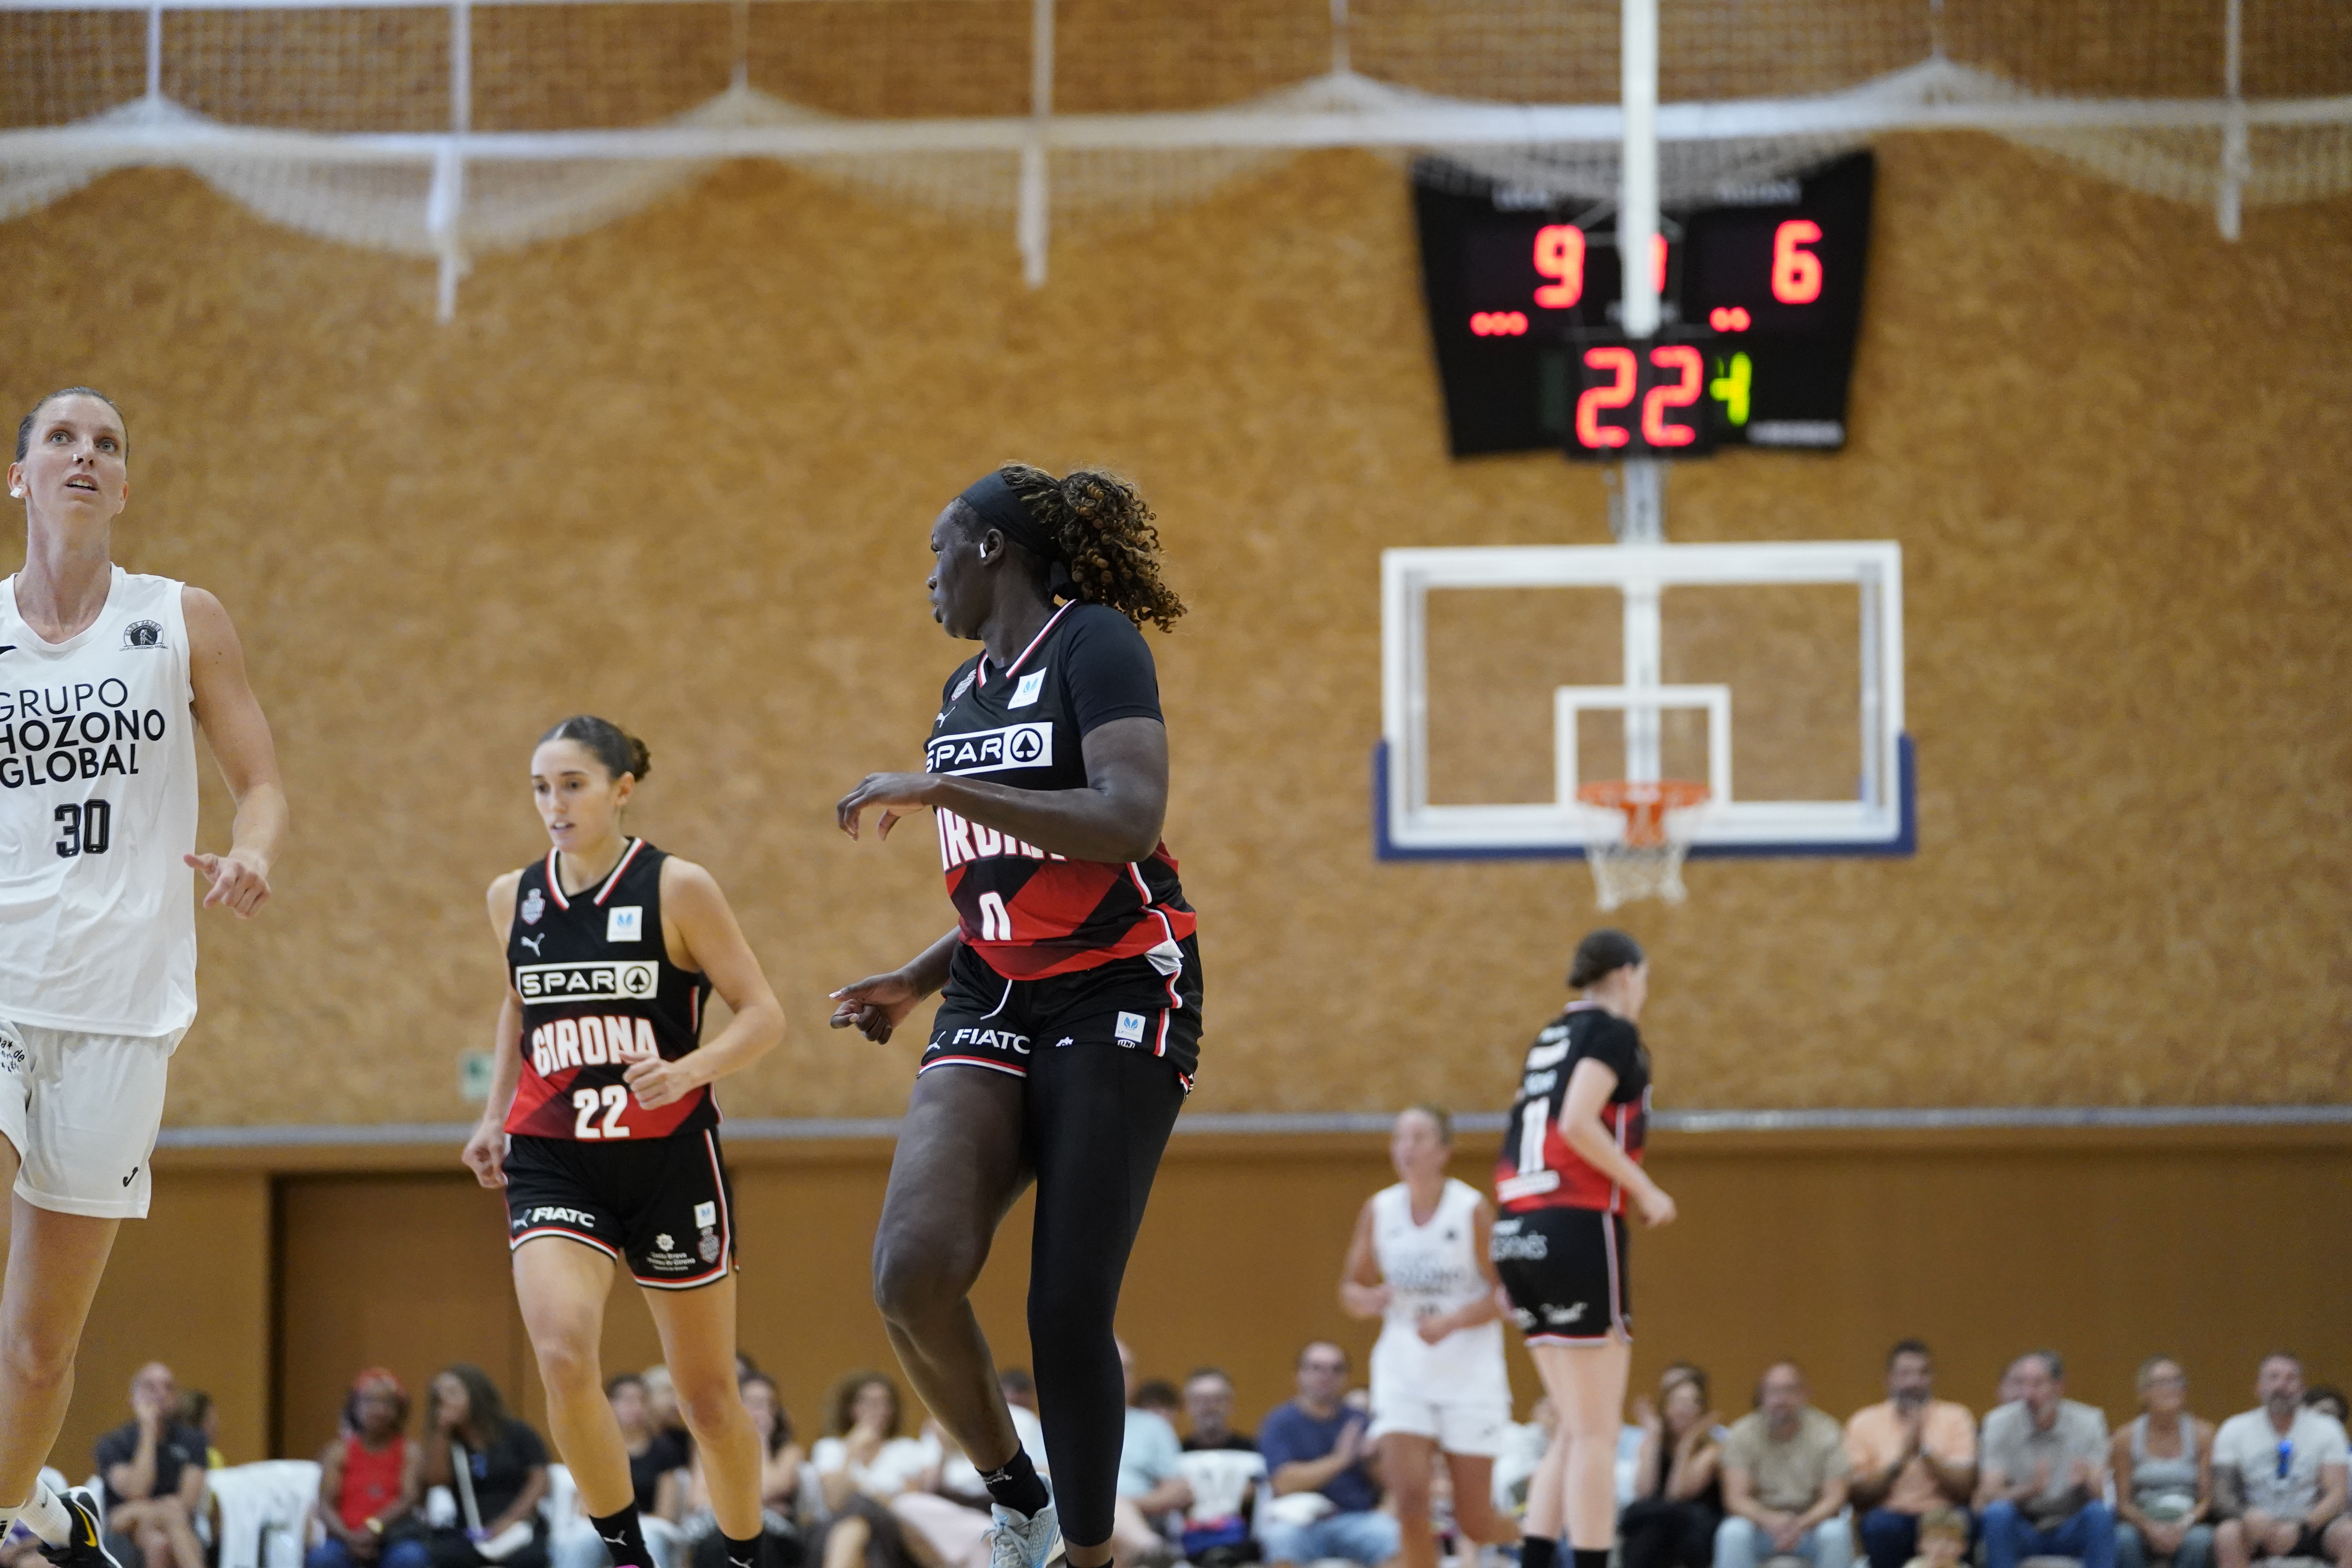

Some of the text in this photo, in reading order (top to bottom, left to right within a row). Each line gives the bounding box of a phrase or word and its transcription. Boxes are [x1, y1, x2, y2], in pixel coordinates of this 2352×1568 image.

[1533, 224, 1585, 309] 9
[1771, 220, 1823, 304] 6
[0, 709, 165, 754] HOZONO
[0, 744, 139, 788] GLOBAL
[54, 799, 111, 858] 30
[522, 970, 614, 995] SPAR
[531, 1016, 661, 1078] GIRONA
[952, 1029, 1030, 1054] FIATC
[573, 1085, 630, 1138] 22
[532, 1207, 595, 1227] FIATC
